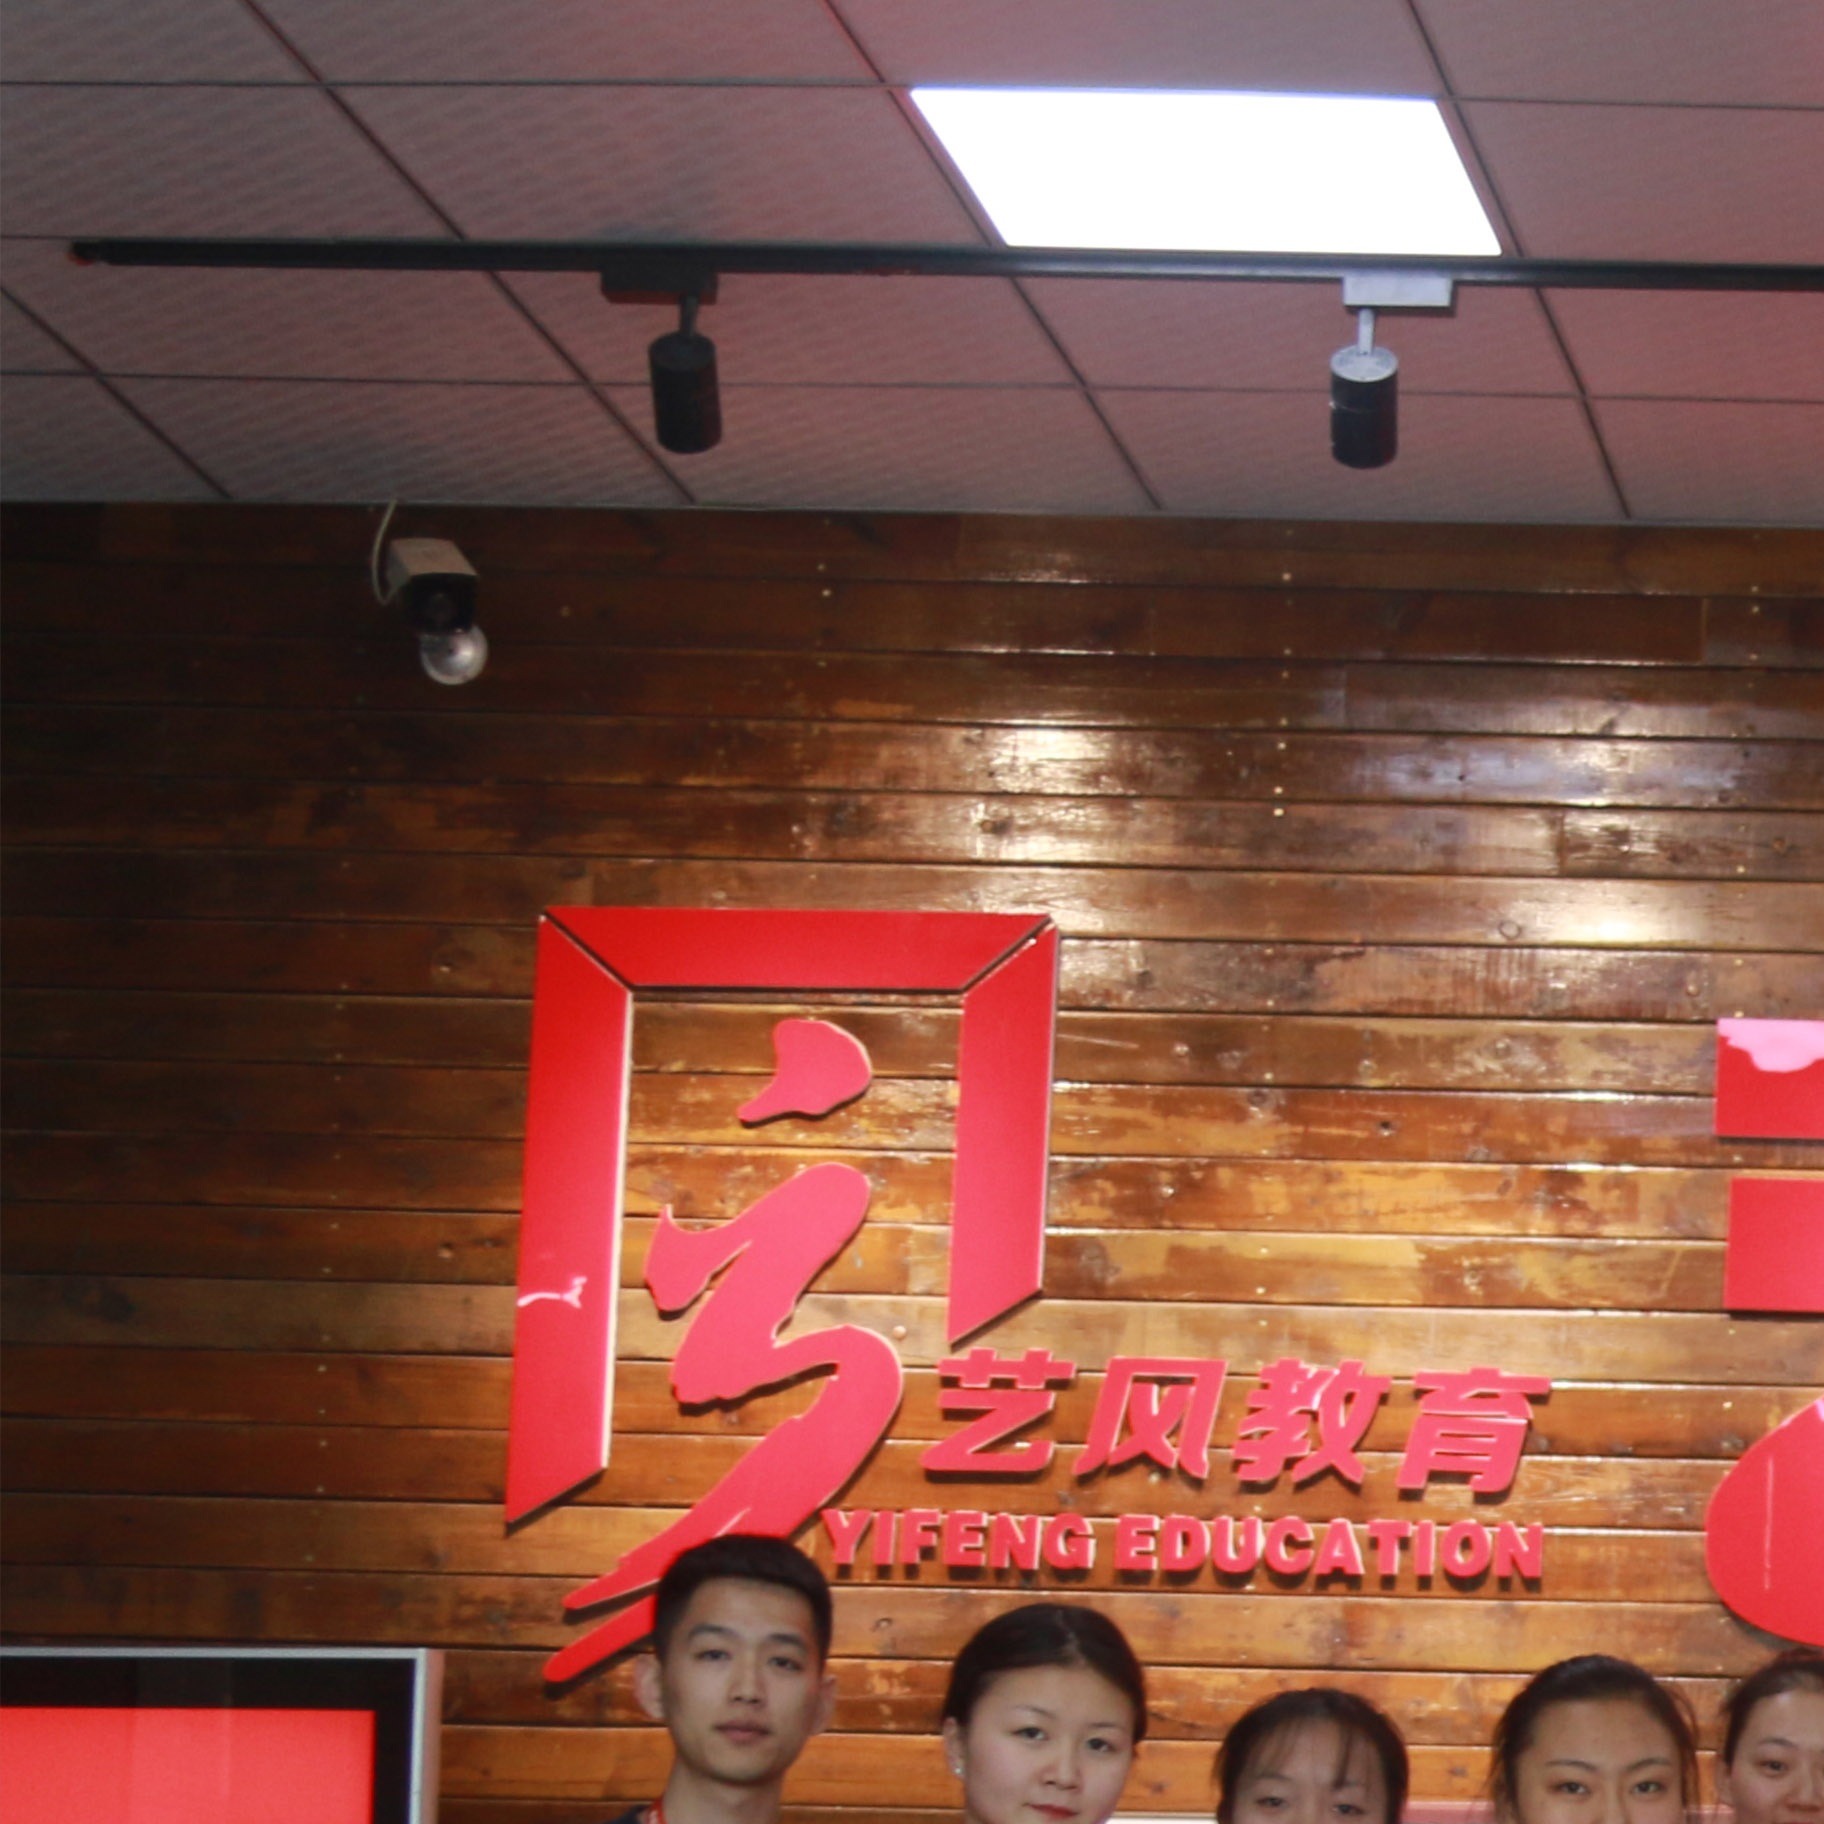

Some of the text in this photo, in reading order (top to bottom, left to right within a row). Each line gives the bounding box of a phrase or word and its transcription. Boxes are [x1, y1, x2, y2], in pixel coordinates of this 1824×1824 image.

[920, 1347, 1551, 1494] 艺风教育
[823, 1508, 1545, 1580] YIFENG EDUCATION
